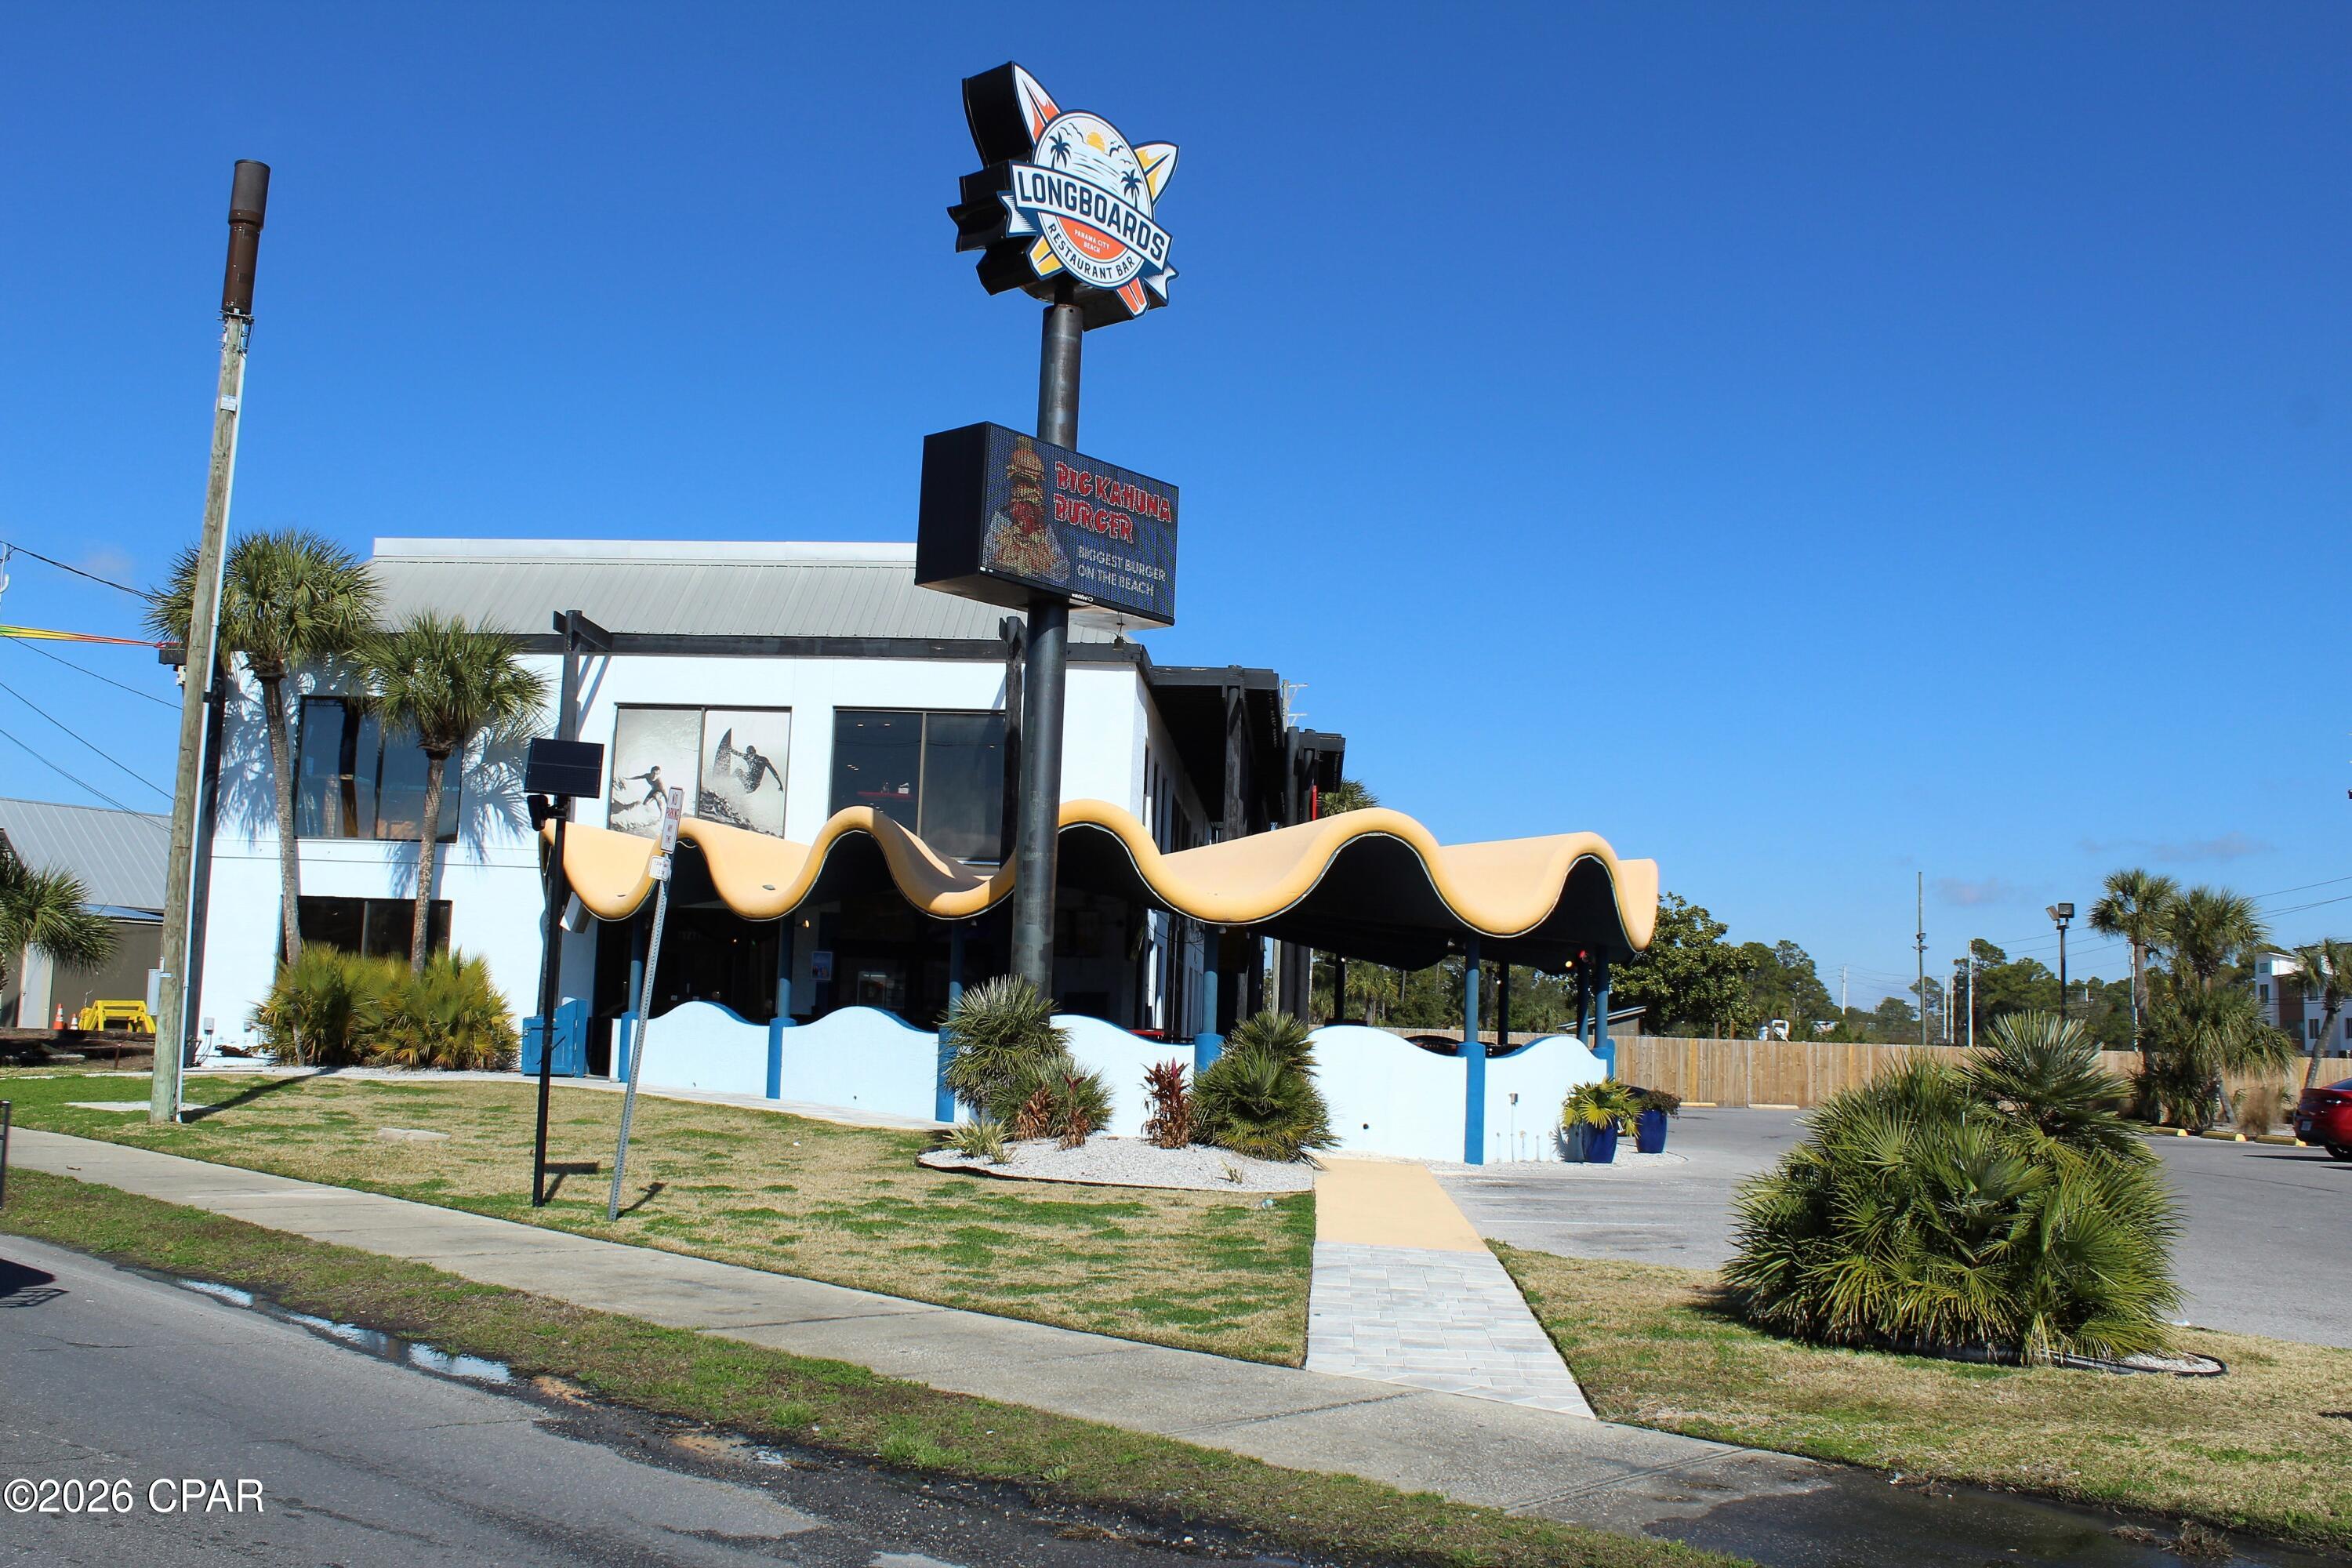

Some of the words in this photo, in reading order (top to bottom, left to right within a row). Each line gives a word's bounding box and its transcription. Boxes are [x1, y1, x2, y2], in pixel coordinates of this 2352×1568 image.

[1017, 170, 1166, 262] LONGBOARDS
[1047, 223, 1112, 280] RESTAURANT
[1115, 256, 1135, 277] BAR
[1074, 229, 1097, 243] PANAMA
[1098, 238, 1110, 250] CITY
[1083, 241, 1101, 253] BEACH
[1055, 461, 1093, 496] BIG
[1095, 475, 1172, 523] KAHUNA
[1054, 493, 1134, 544] BURGER
[1077, 564, 1094, 579] ON
[1097, 569, 1116, 586] THE
[1119, 575, 1154, 597] BEACH
[1078, 545, 1123, 569] BIGGEST
[1125, 558, 1166, 582] BURGER
[671, 792, 678, 806] NO
